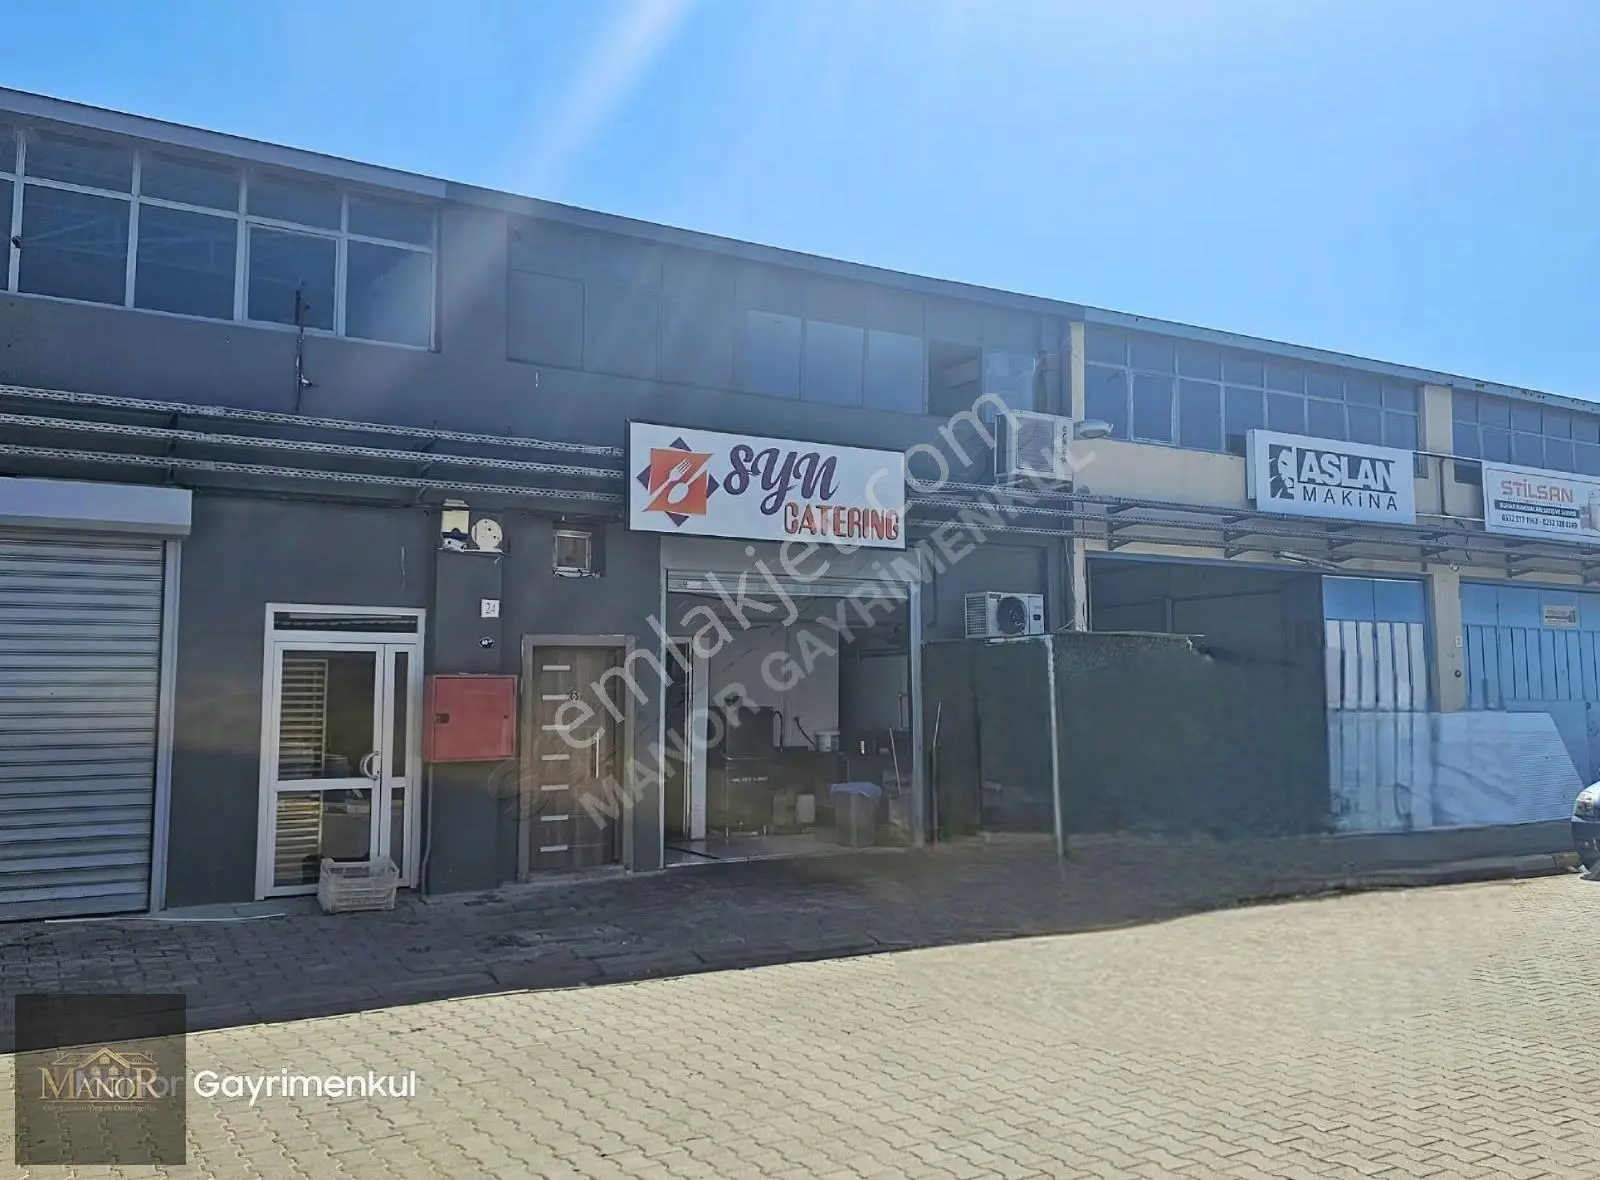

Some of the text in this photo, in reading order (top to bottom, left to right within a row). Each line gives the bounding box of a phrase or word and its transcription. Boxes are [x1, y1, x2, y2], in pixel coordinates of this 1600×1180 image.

[1300, 450, 1395, 493] ASLAN
[1303, 486, 1398, 511] MAKİNA
[1501, 478, 1573, 503] STİLSAN
[784, 502, 899, 540] CATERING
